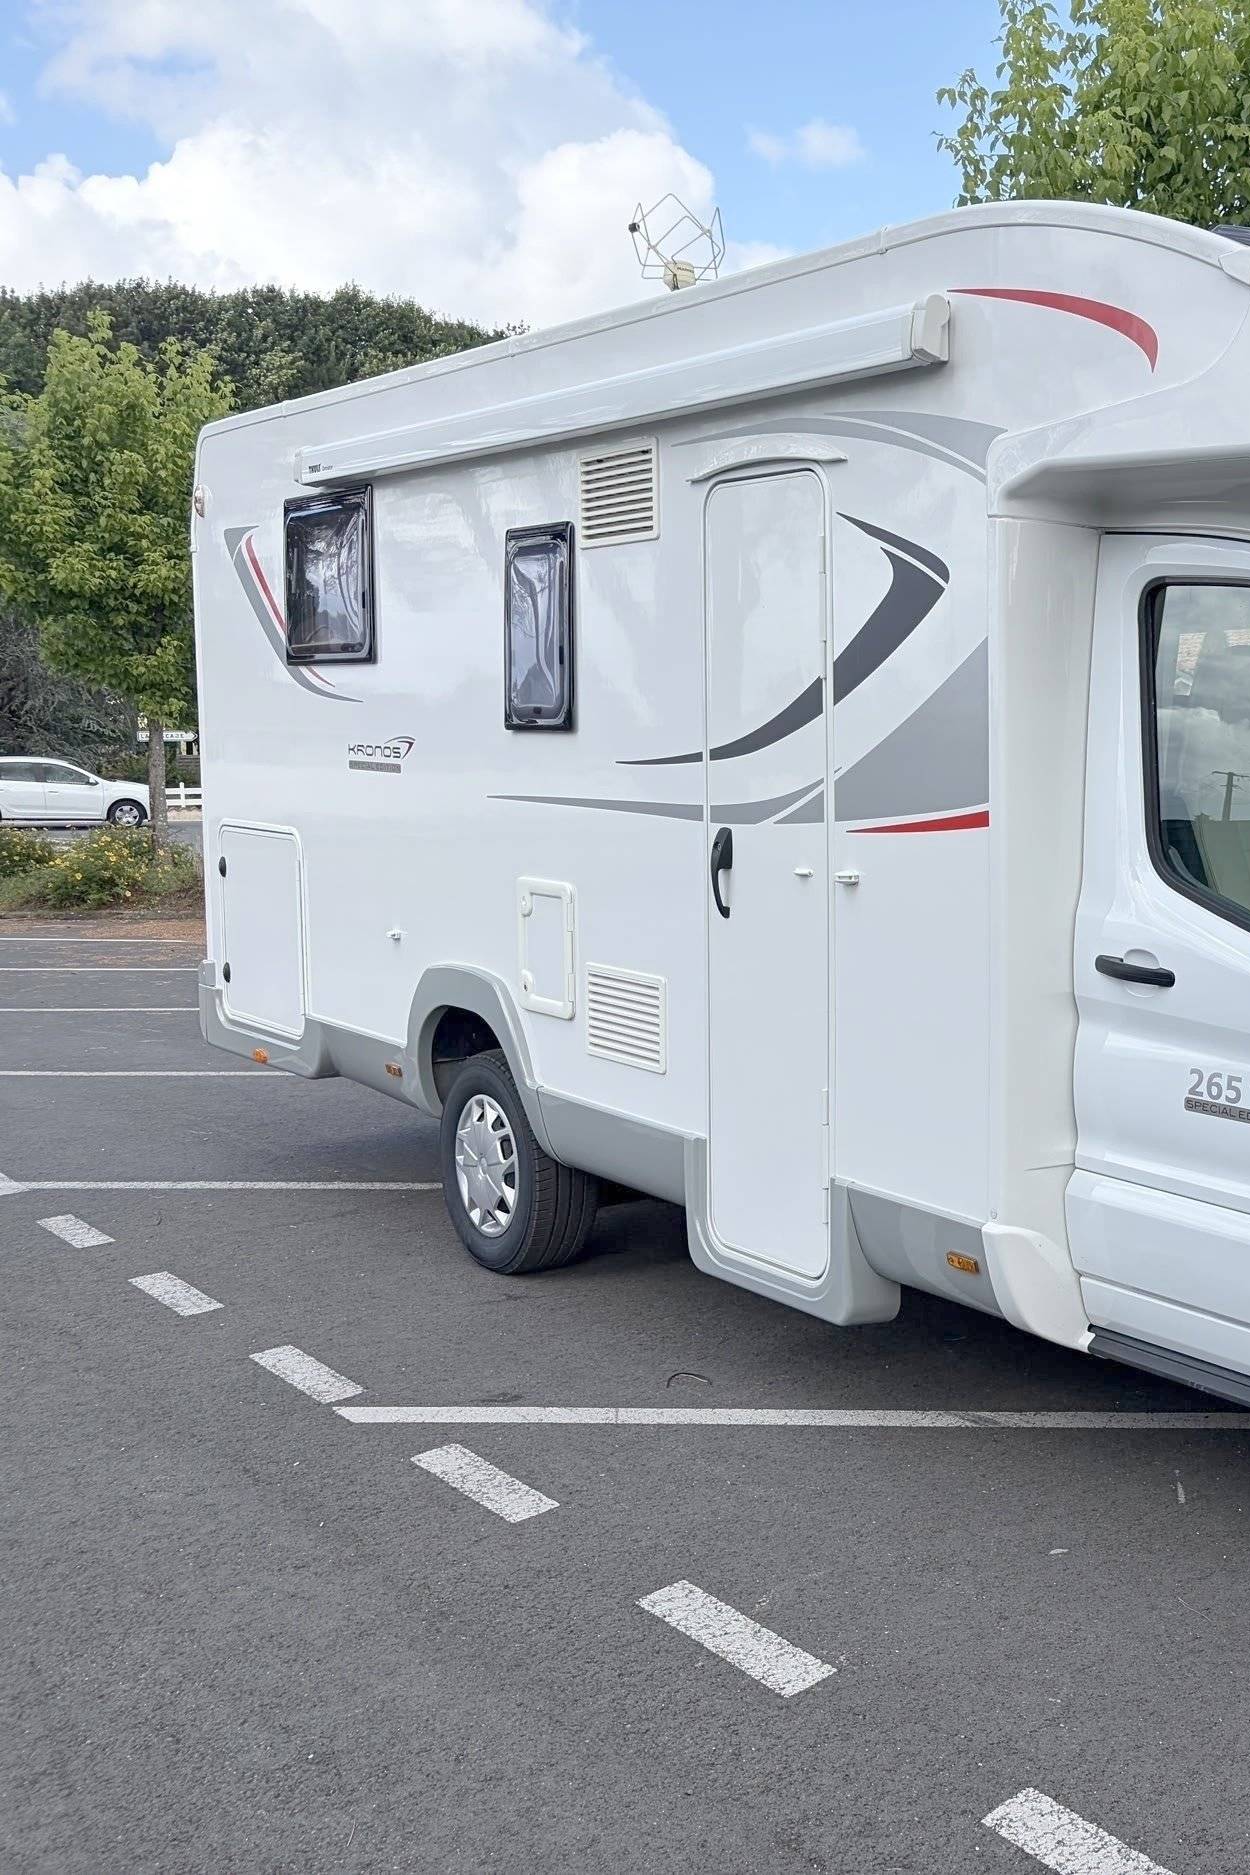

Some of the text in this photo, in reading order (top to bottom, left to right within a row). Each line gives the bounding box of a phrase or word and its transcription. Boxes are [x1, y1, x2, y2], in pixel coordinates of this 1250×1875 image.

[347, 743, 402, 759] KRONOS
[1187, 1067, 1243, 1105] 265
[1185, 1098, 1237, 1118] SPECIAL
